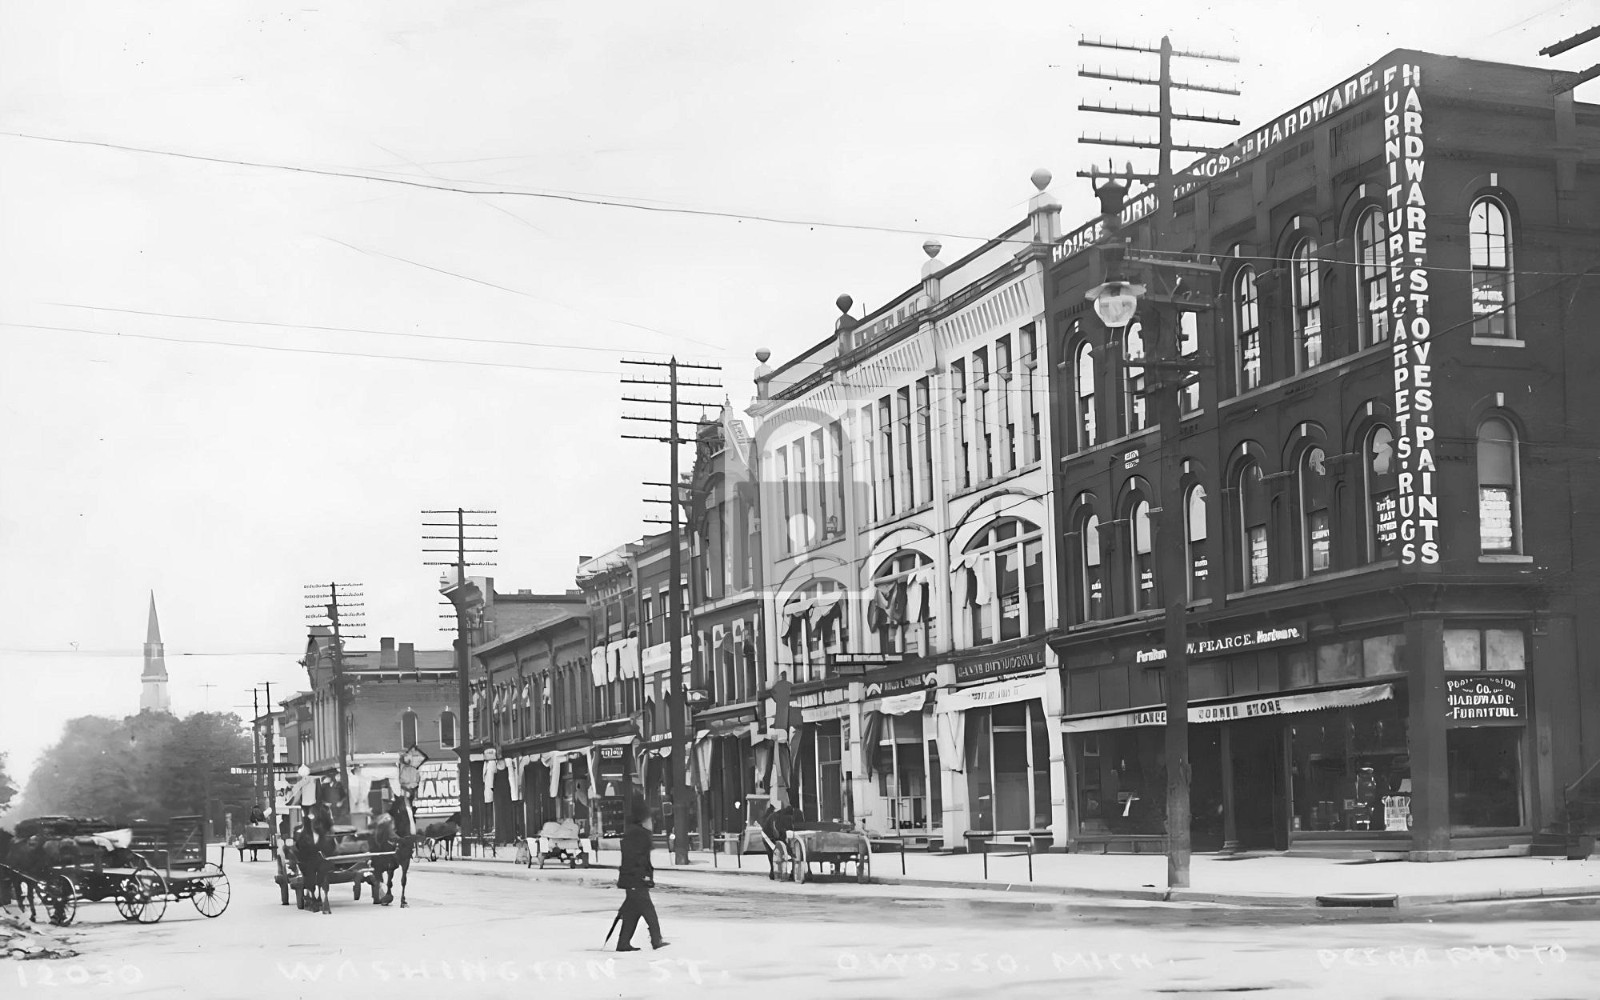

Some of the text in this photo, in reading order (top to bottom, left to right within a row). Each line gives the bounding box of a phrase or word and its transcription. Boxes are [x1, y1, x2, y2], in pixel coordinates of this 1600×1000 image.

[1391, 296, 1412, 459] CARPETS
[1402, 63, 1440, 565] HARDWARE STOVES PAINTS
[1398, 472, 1416, 565] RUGS
